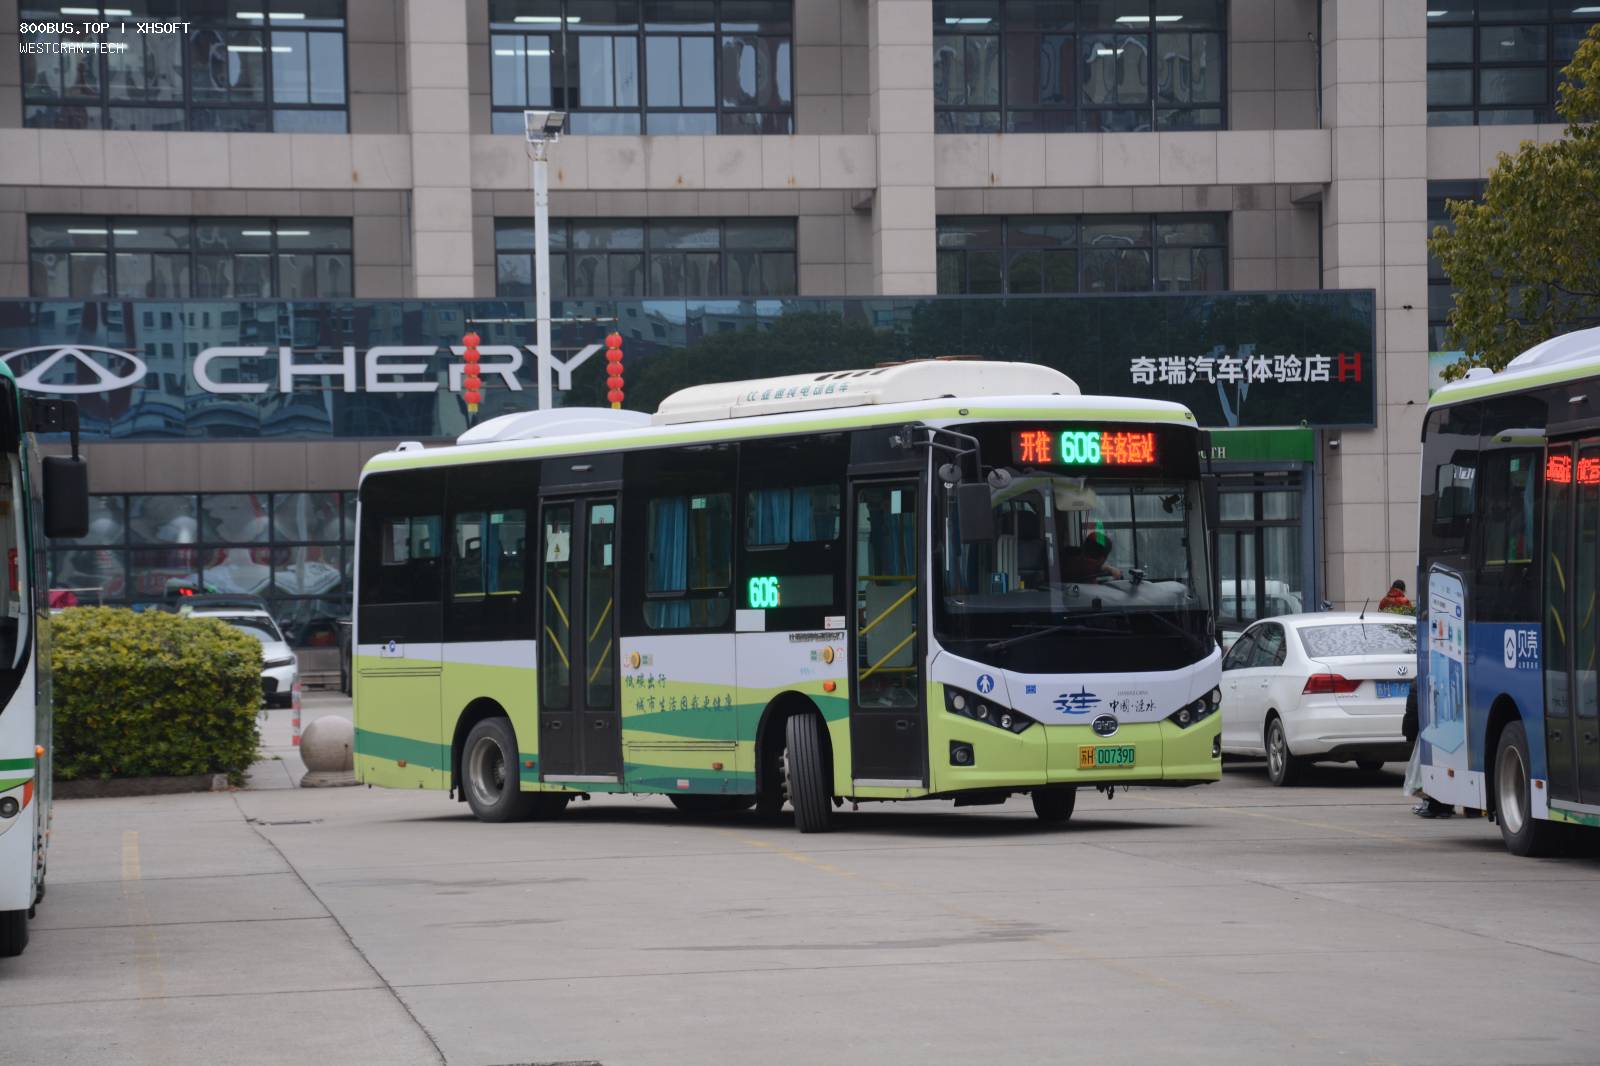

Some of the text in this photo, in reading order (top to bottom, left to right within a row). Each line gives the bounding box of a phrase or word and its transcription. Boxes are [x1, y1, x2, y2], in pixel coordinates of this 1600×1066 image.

[193, 344, 603, 393] CHERY
[1130, 354, 1332, 385] 奇瑞汽车体验店
[1020, 431, 1051, 463] 开往
[1061, 431, 1101, 463] 606
[749, 576, 778, 608] 606
[1518, 630, 1538, 659] 贝壳
